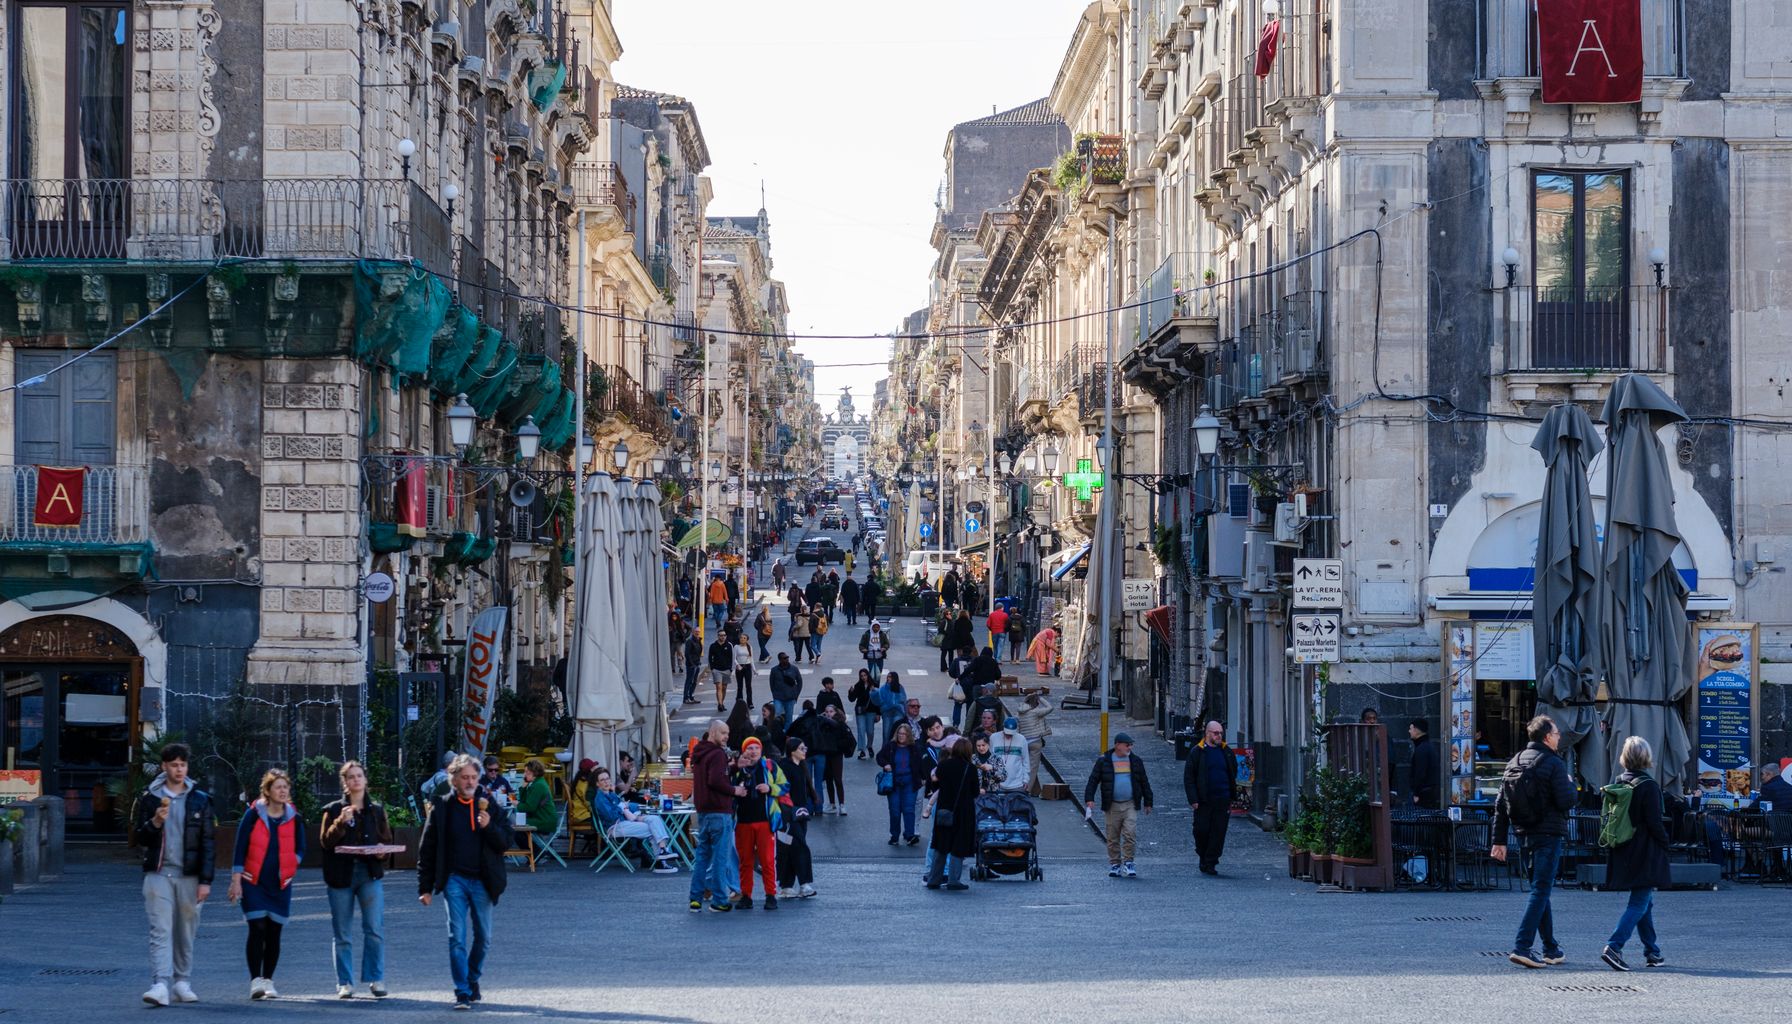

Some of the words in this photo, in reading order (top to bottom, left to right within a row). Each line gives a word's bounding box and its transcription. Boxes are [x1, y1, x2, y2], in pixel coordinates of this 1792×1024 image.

[1565, 19, 1618, 78] A
[44, 482, 75, 514] A
[1705, 749, 1711, 758] 3
